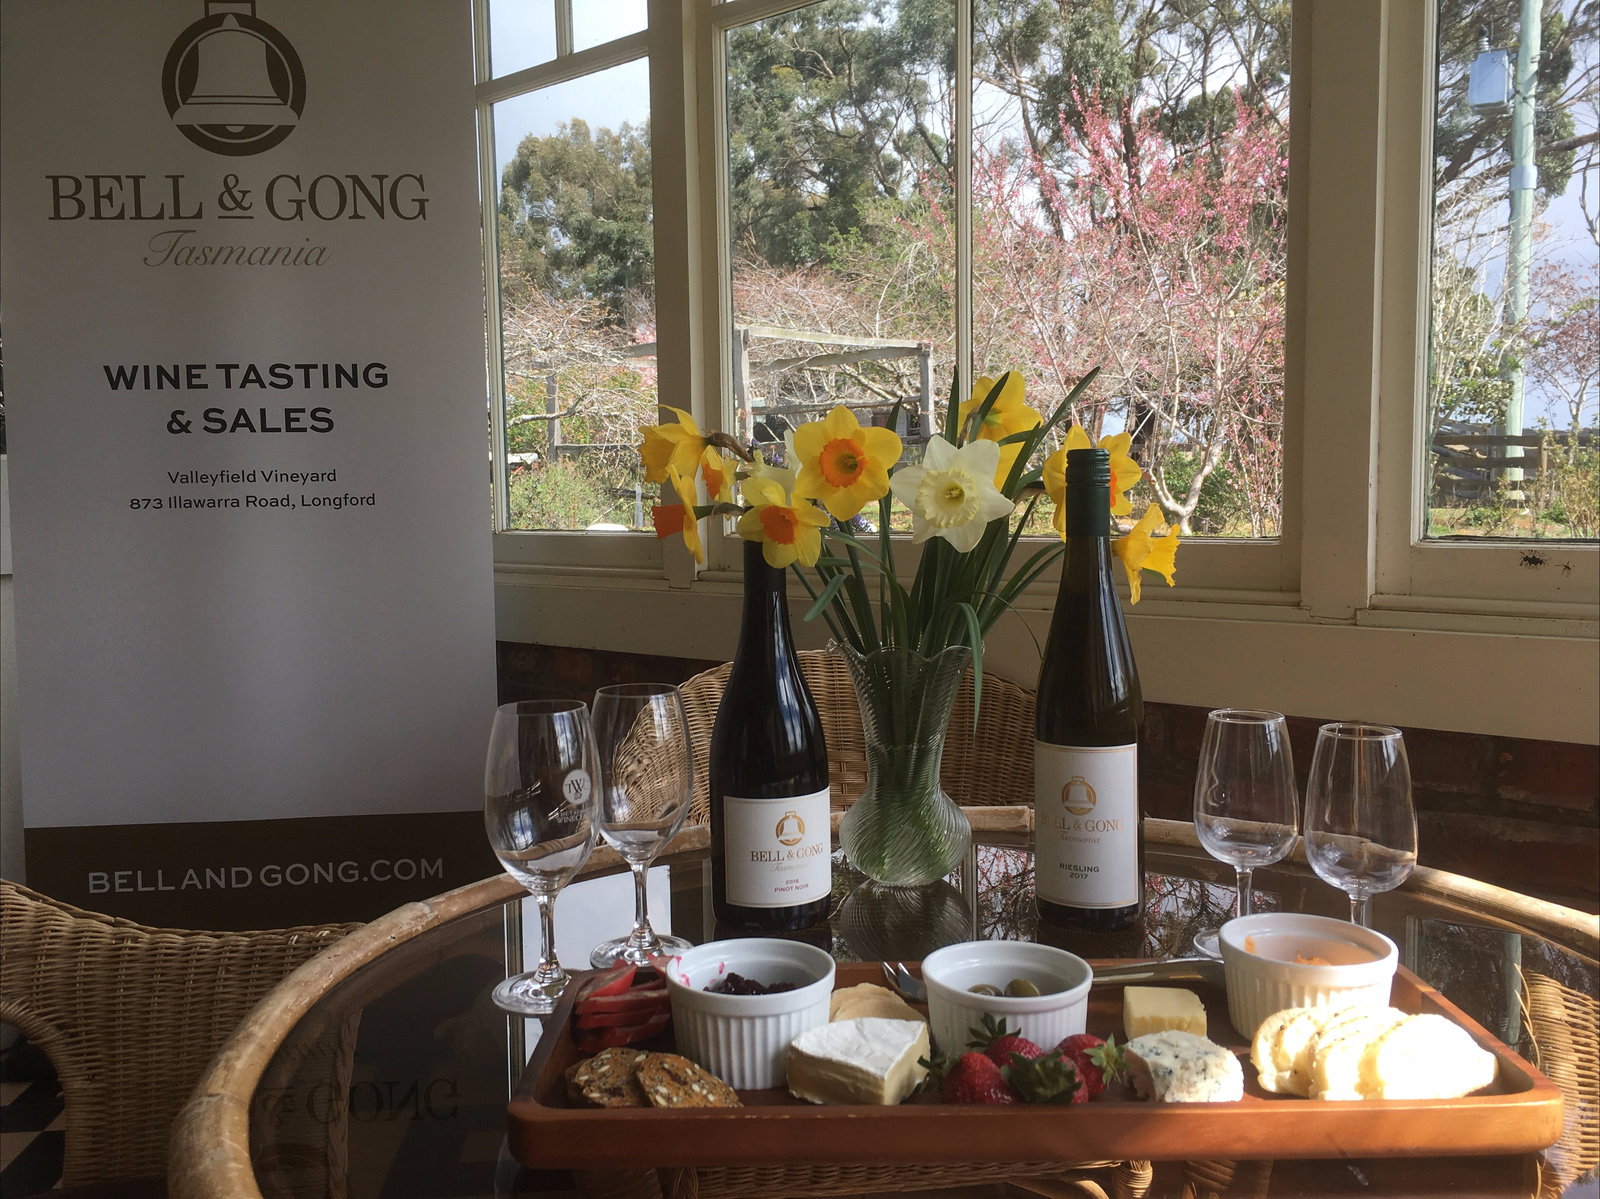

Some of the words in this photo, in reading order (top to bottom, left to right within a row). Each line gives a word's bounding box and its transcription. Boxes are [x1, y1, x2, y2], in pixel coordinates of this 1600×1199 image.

[45, 174, 204, 221] BELL
[217, 173, 254, 219] &
[264, 173, 430, 222] GONG
[143, 229, 333, 268] Tasmania
[103, 364, 208, 391] WINE
[216, 362, 389, 390] TASTING
[166, 408, 193, 434] &
[202, 407, 335, 434] SALES
[167, 469, 257, 487] Valleyfield
[260, 468, 337, 486] Vineyard
[129, 497, 164, 510] 873
[168, 496, 241, 509] Illawarra
[245, 494, 297, 511] Road,
[300, 492, 376, 510] Longford
[1085, 818, 1126, 833] GONG
[750, 850, 785, 862] BELL
[796, 843, 824, 859] GONG
[88, 857, 444, 895] BELLANDGONG.COM
[1059, 862, 1100, 873] RIESLING
[1069, 872, 1089, 880] 2017
